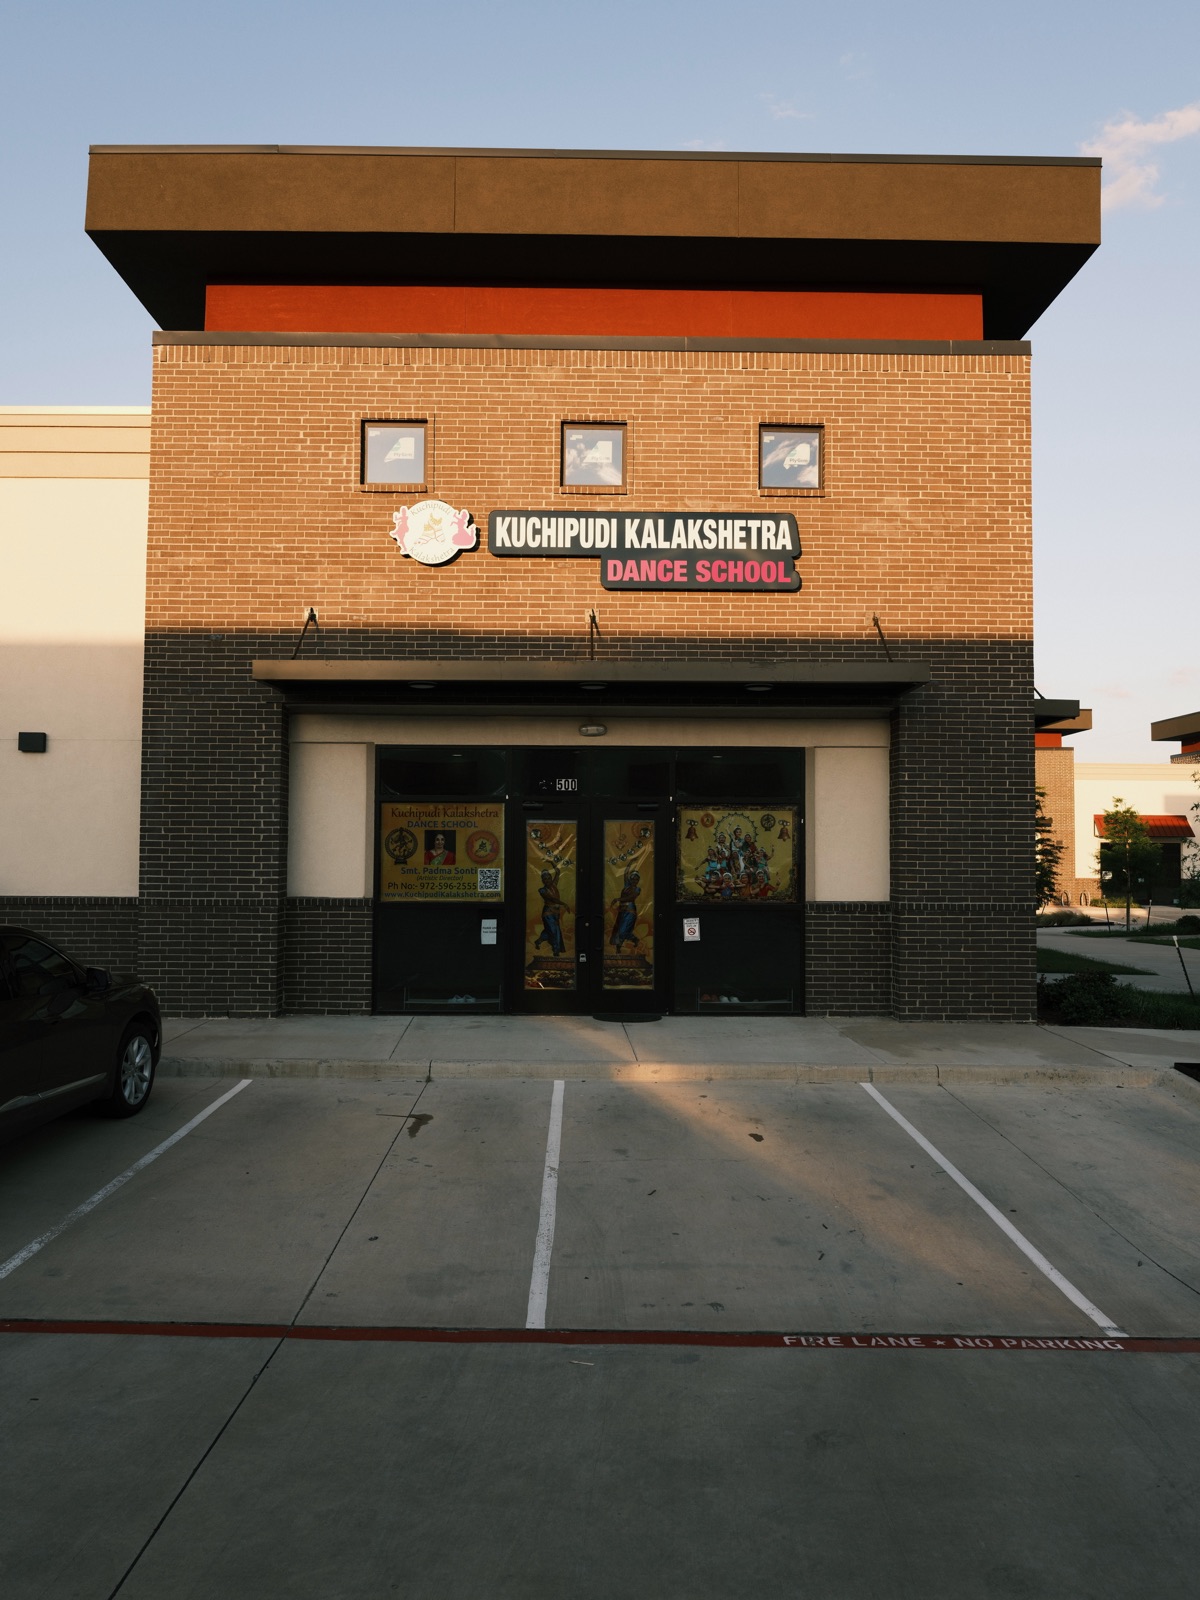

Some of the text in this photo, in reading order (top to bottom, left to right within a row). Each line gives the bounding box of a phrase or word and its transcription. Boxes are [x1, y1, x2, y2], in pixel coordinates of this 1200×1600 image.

[410, 501, 452, 516] Kuchipudi
[495, 516, 793, 551] KUCHIPUDI KALAKSHETRA
[409, 546, 455, 563] Kalakshetra
[607, 559, 792, 583] DANCE SCHOOL
[557, 779, 577, 790] 500
[391, 806, 499, 820] Kuchipudi Kalakshetra
[407, 820, 478, 828] DANCE SCHOOL
[400, 867, 477, 875] Smt. Padma Sonti
[387, 882, 399, 890] Ph
[420, 882, 477, 890] 972-596-2555
[384, 891, 501, 899] www.KuchipudiKalakshetra.com
[783, 1335, 1124, 1350] FIRE LANE NO PARKING
